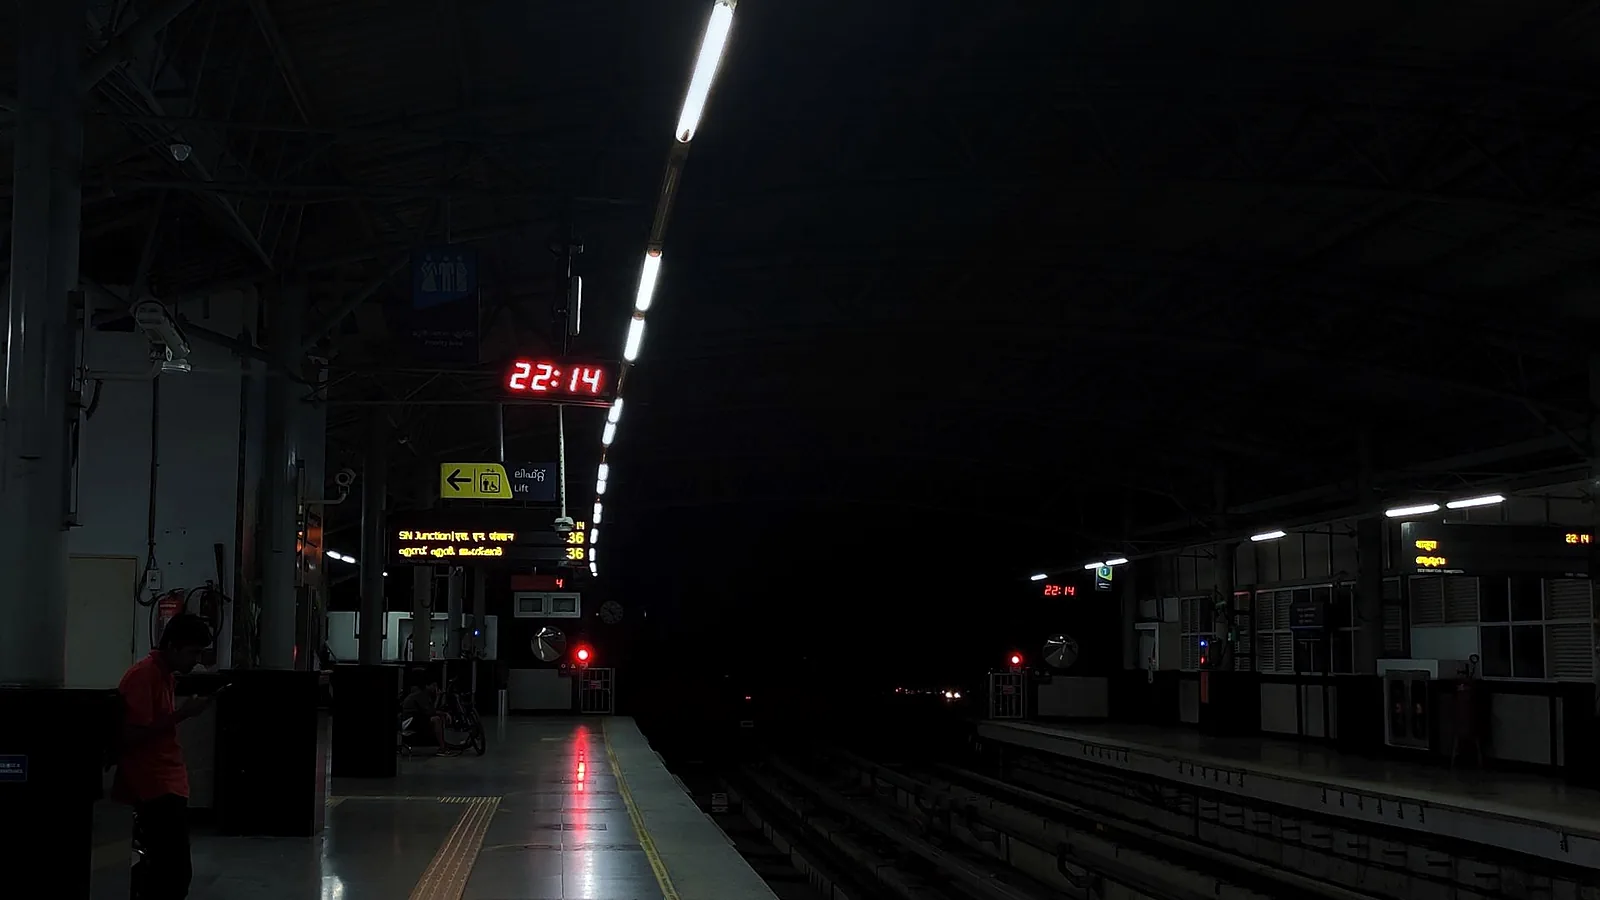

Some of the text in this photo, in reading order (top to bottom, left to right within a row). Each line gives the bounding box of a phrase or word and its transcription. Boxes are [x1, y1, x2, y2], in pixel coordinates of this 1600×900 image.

[509, 362, 602, 393] 22:14
[514, 468, 546, 482] ലിഫ്റ്റ്
[514, 483, 529, 493] Lift
[398, 530, 413, 541] SN
[565, 547, 584, 559] 36
[1044, 584, 1075, 596] 22:14
